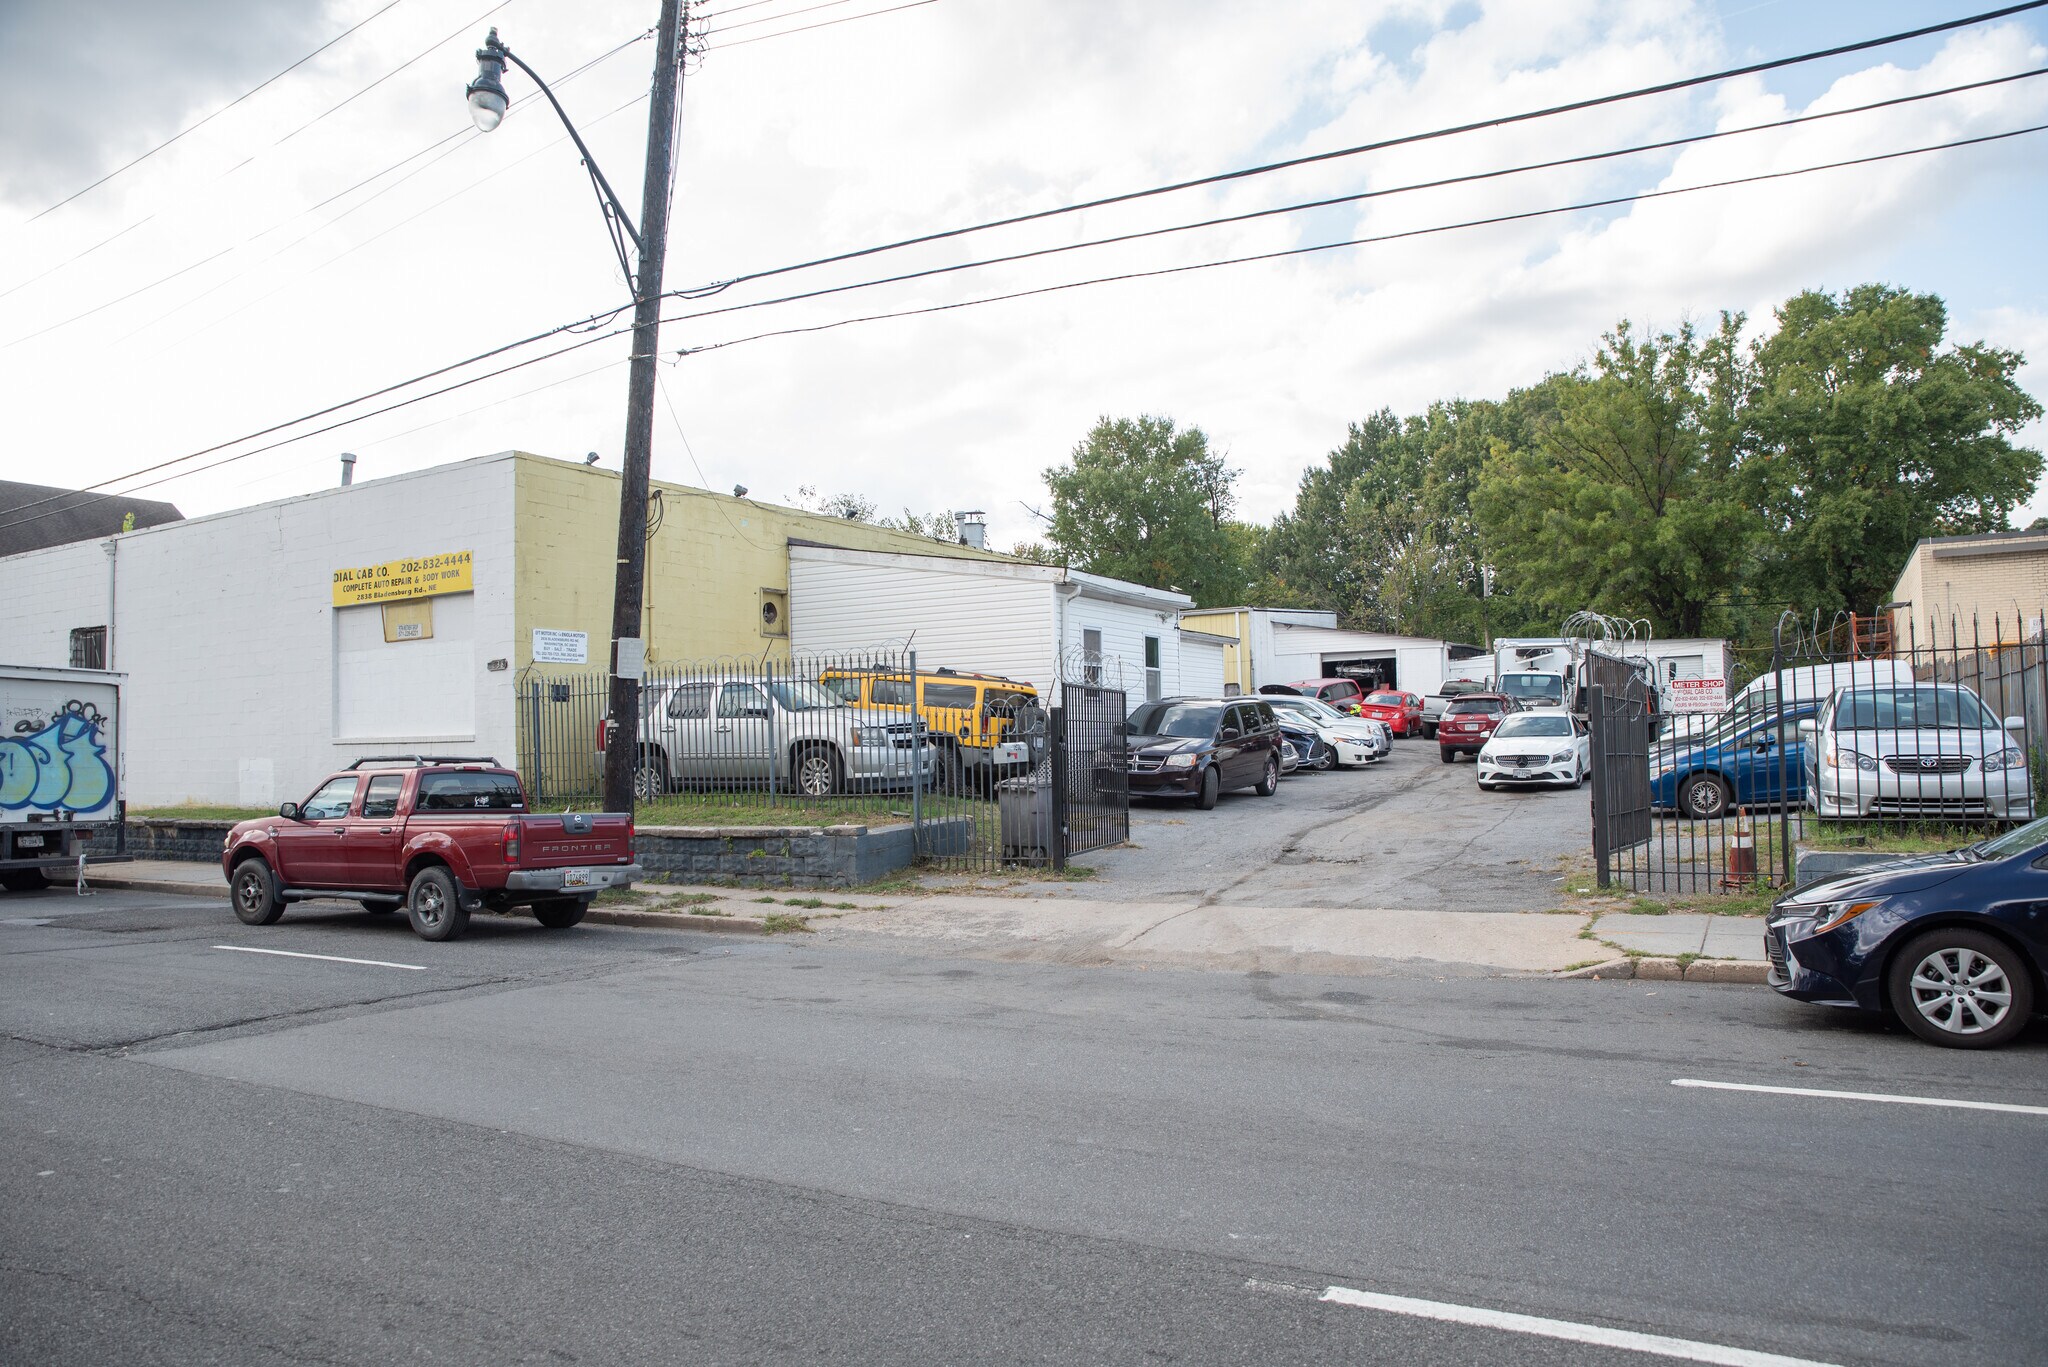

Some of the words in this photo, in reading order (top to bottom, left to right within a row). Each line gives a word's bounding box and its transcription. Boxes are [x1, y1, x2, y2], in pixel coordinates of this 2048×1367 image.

[333, 571, 353, 583] DIAL
[356, 568, 373, 580] CAB
[376, 566, 390, 578] CO.
[400, 553, 471, 574] 202-832-4444
[342, 581, 372, 593] COMPLETE
[373, 579, 390, 589] AUTO
[390, 576, 412, 588] REPAIR
[414, 575, 420, 584] &
[422, 572, 439, 583] BODY
[441, 569, 460, 580] WORK
[356, 593, 373, 601] 2838
[373, 589, 412, 599] Bladensburg
[1674, 681, 1700, 689] METER
[1702, 680, 1724, 688] SHOP
[542, 844, 611, 852] FRONTIER
